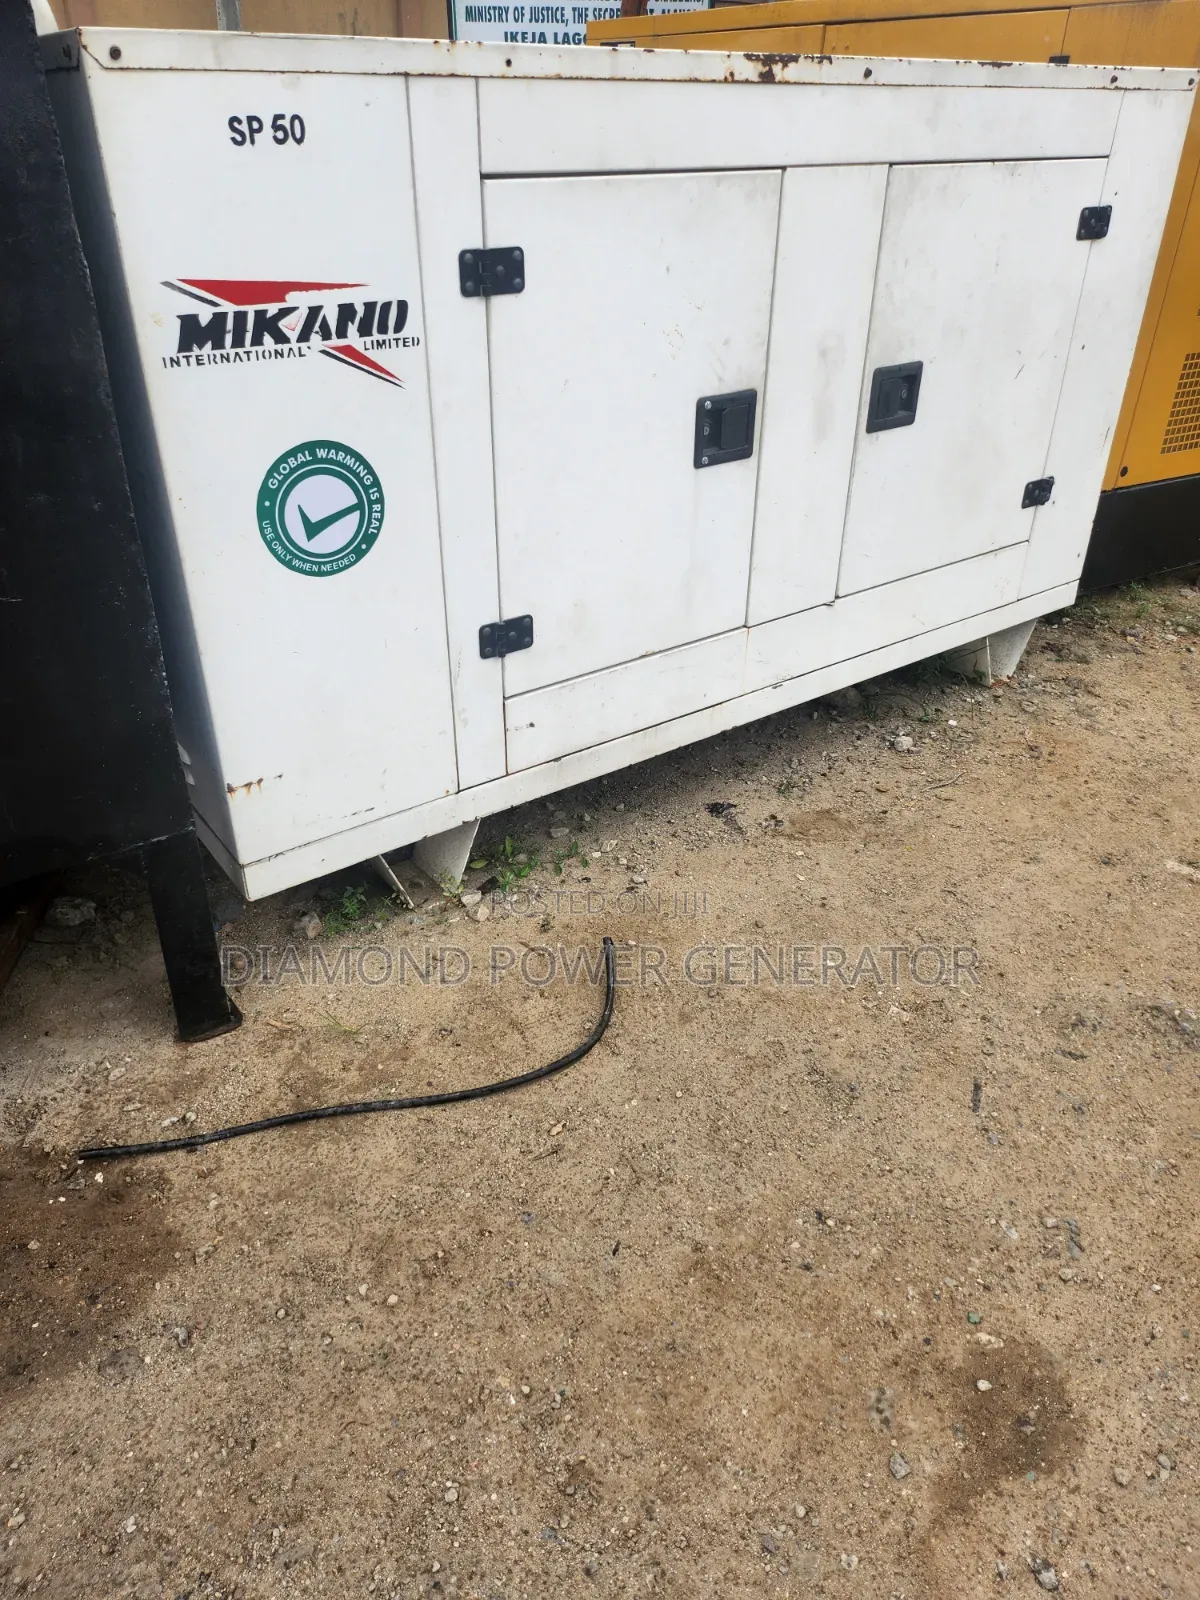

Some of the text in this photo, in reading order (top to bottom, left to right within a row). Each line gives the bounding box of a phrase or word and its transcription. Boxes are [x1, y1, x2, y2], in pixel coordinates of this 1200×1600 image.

[465, 5, 510, 24] MINISTRY
[513, 6, 525, 24] OF
[528, 6, 569, 27] JUSTICE,
[572, 7, 589, 24] THE
[504, 31, 548, 45] IKEJA
[228, 114, 306, 147] SP 50
[176, 299, 409, 354] MIKANO
[162, 336, 421, 369] INTERNATIONAL LIMITED
[268, 448, 381, 535] GLOBAL WARMING IS REAL
[262, 520, 357, 572] USE ONLY WHEN NEEDED
